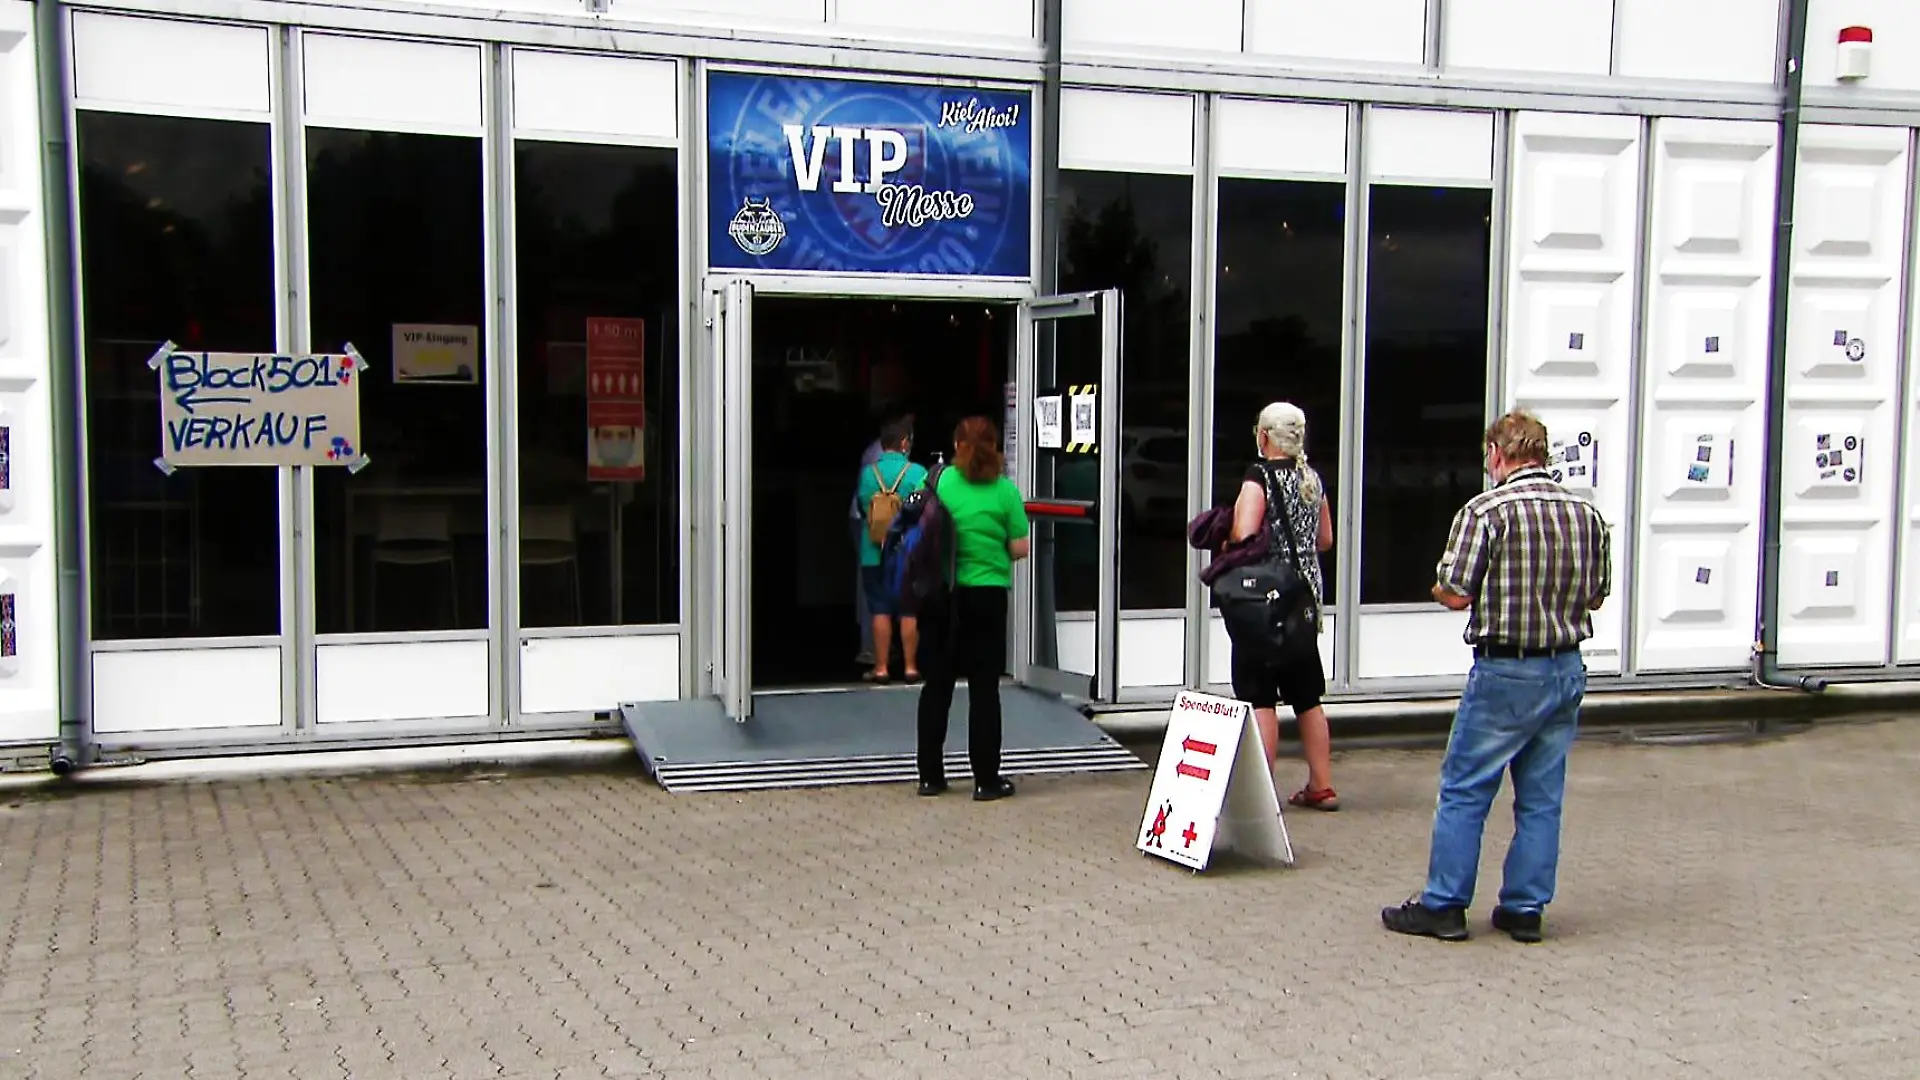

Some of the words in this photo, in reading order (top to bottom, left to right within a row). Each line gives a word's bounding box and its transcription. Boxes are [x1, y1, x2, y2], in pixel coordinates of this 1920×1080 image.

[937, 97, 977, 128] Kiel
[965, 104, 1019, 133] Ahoi!
[782, 124, 908, 193] VIP
[877, 184, 974, 227] Messe
[168, 412, 327, 451] VERKAUF
[1180, 695, 1213, 714] Spende
